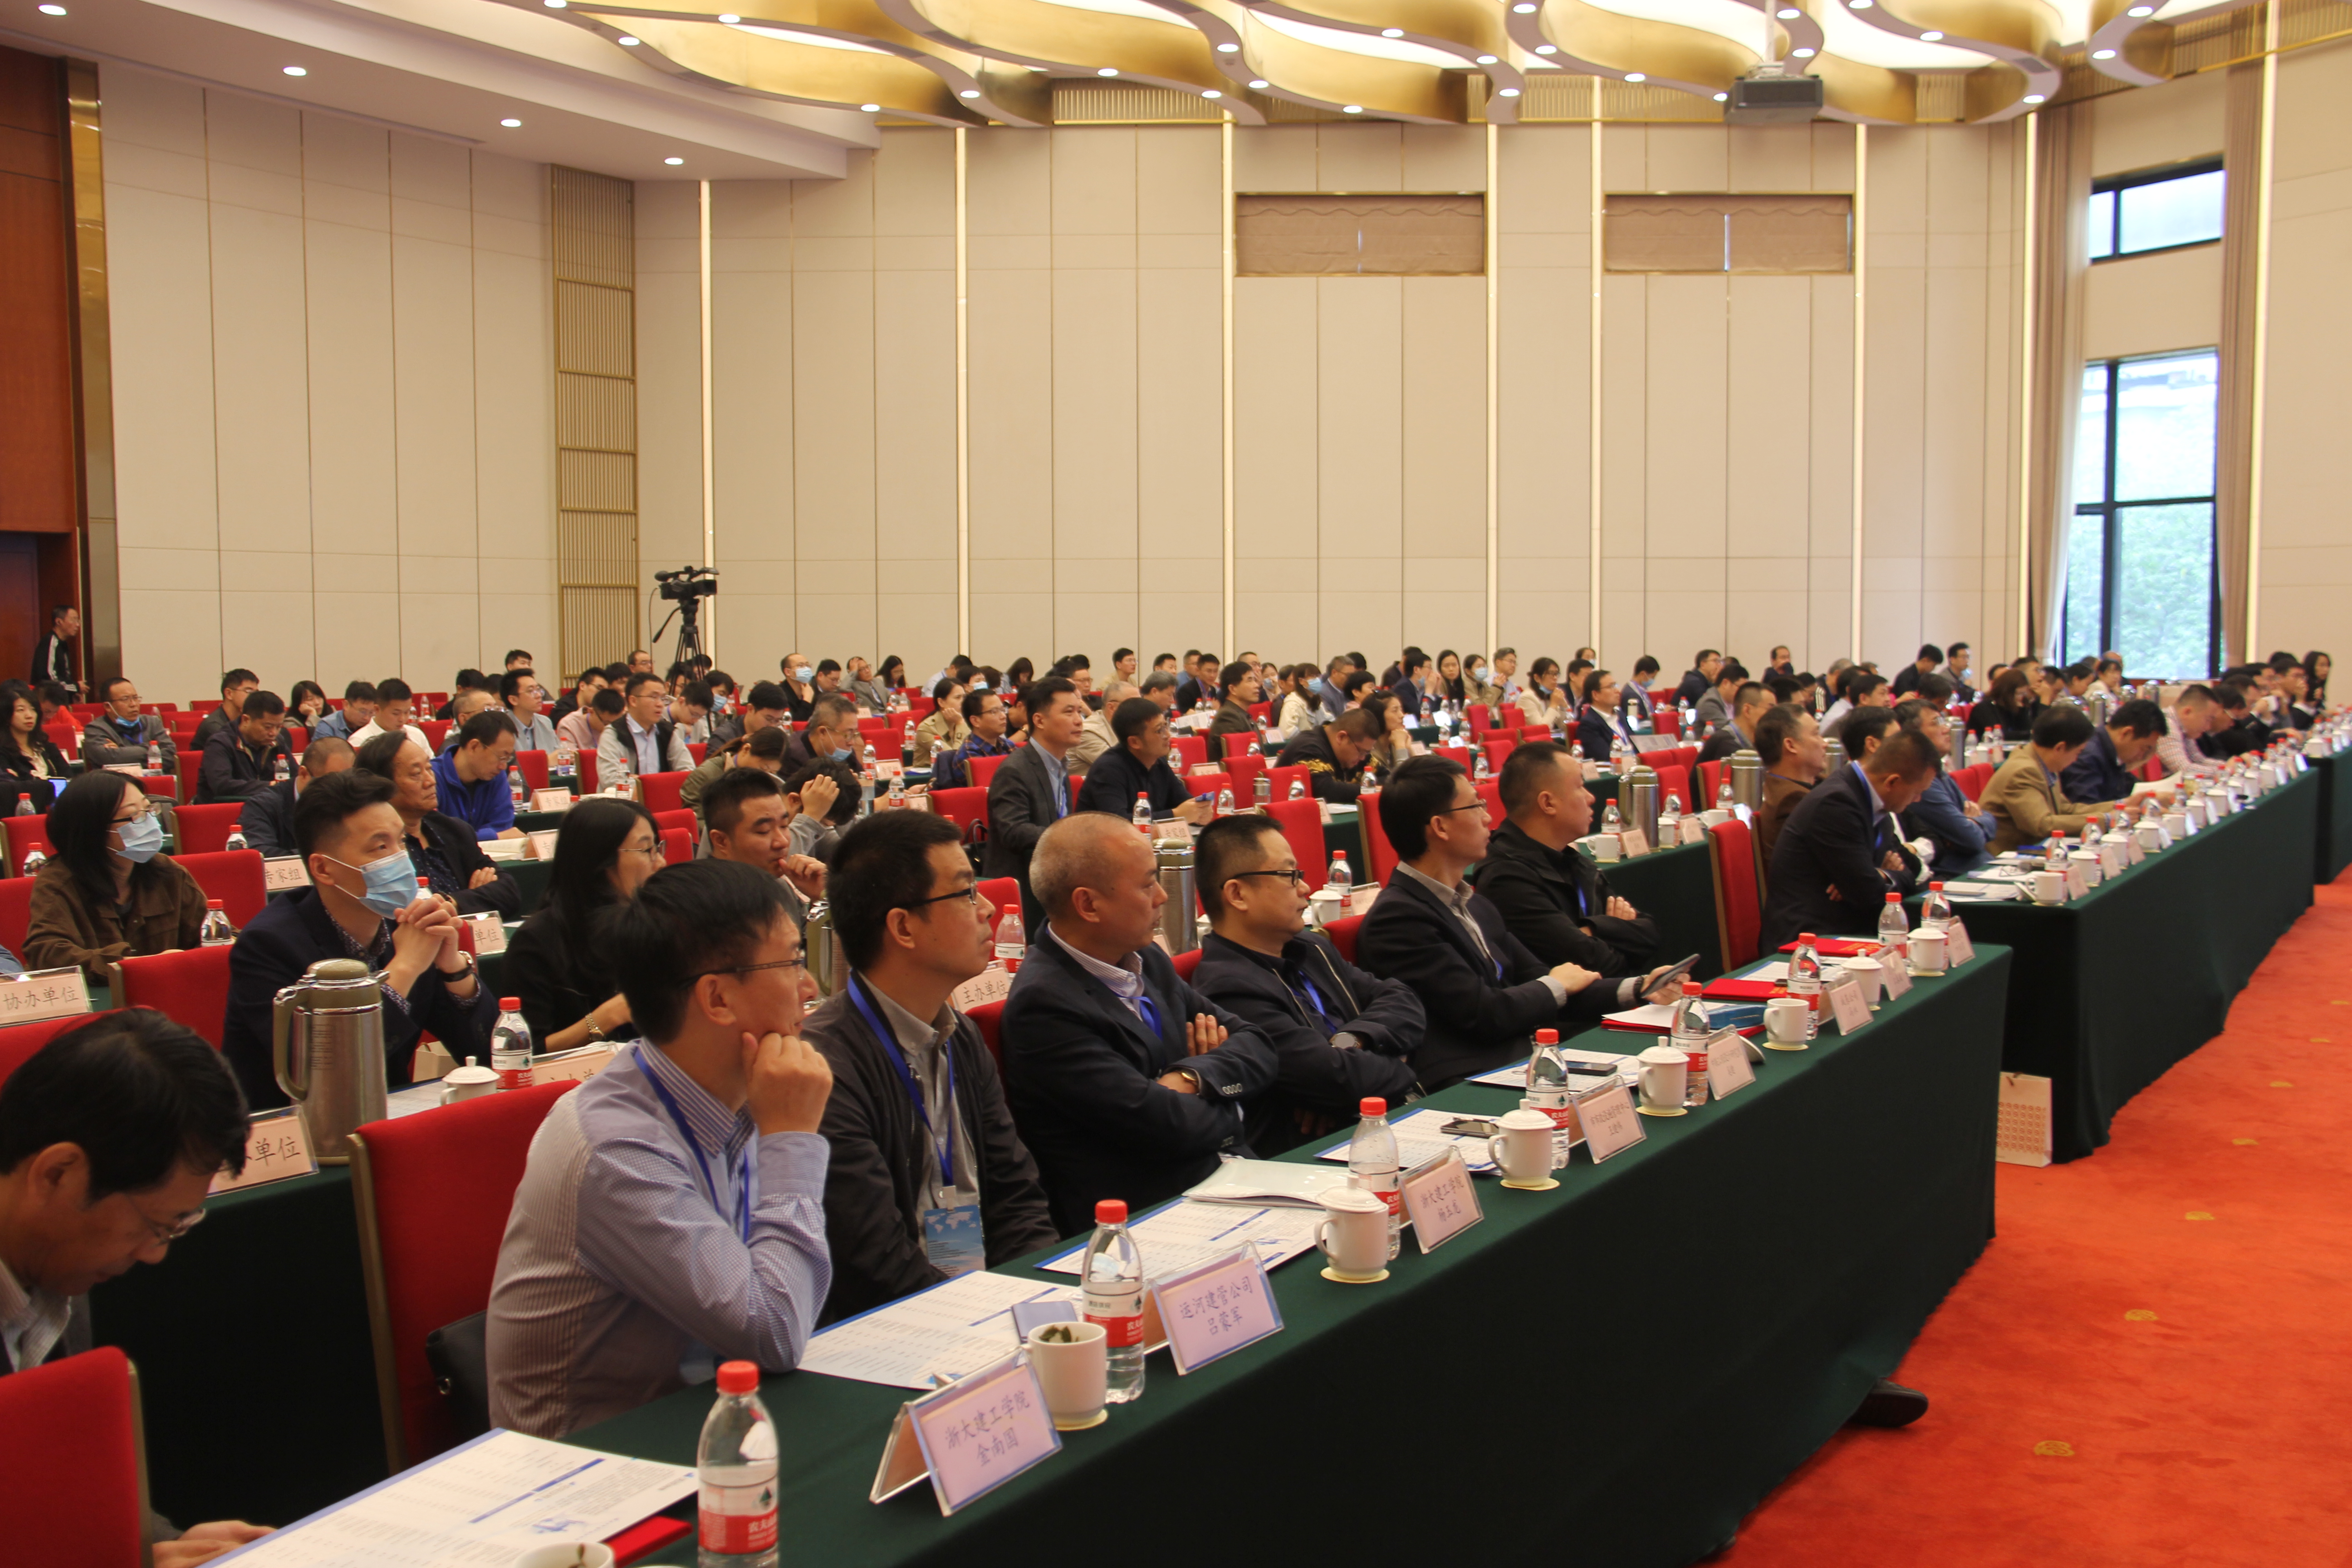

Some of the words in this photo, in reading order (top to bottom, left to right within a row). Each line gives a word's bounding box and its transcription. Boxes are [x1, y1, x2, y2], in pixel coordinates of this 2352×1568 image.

[265, 867, 302, 884] 专家组
[3, 986, 79, 1011] 协办单位
[963, 980, 1009, 1004] 主办单位
[246, 1136, 301, 1166] 单位
[1180, 1276, 1253, 1319] 运河建管公司
[945, 1390, 1030, 1450] 浙大建工学院
[976, 1427, 1018, 1467] 金南国
